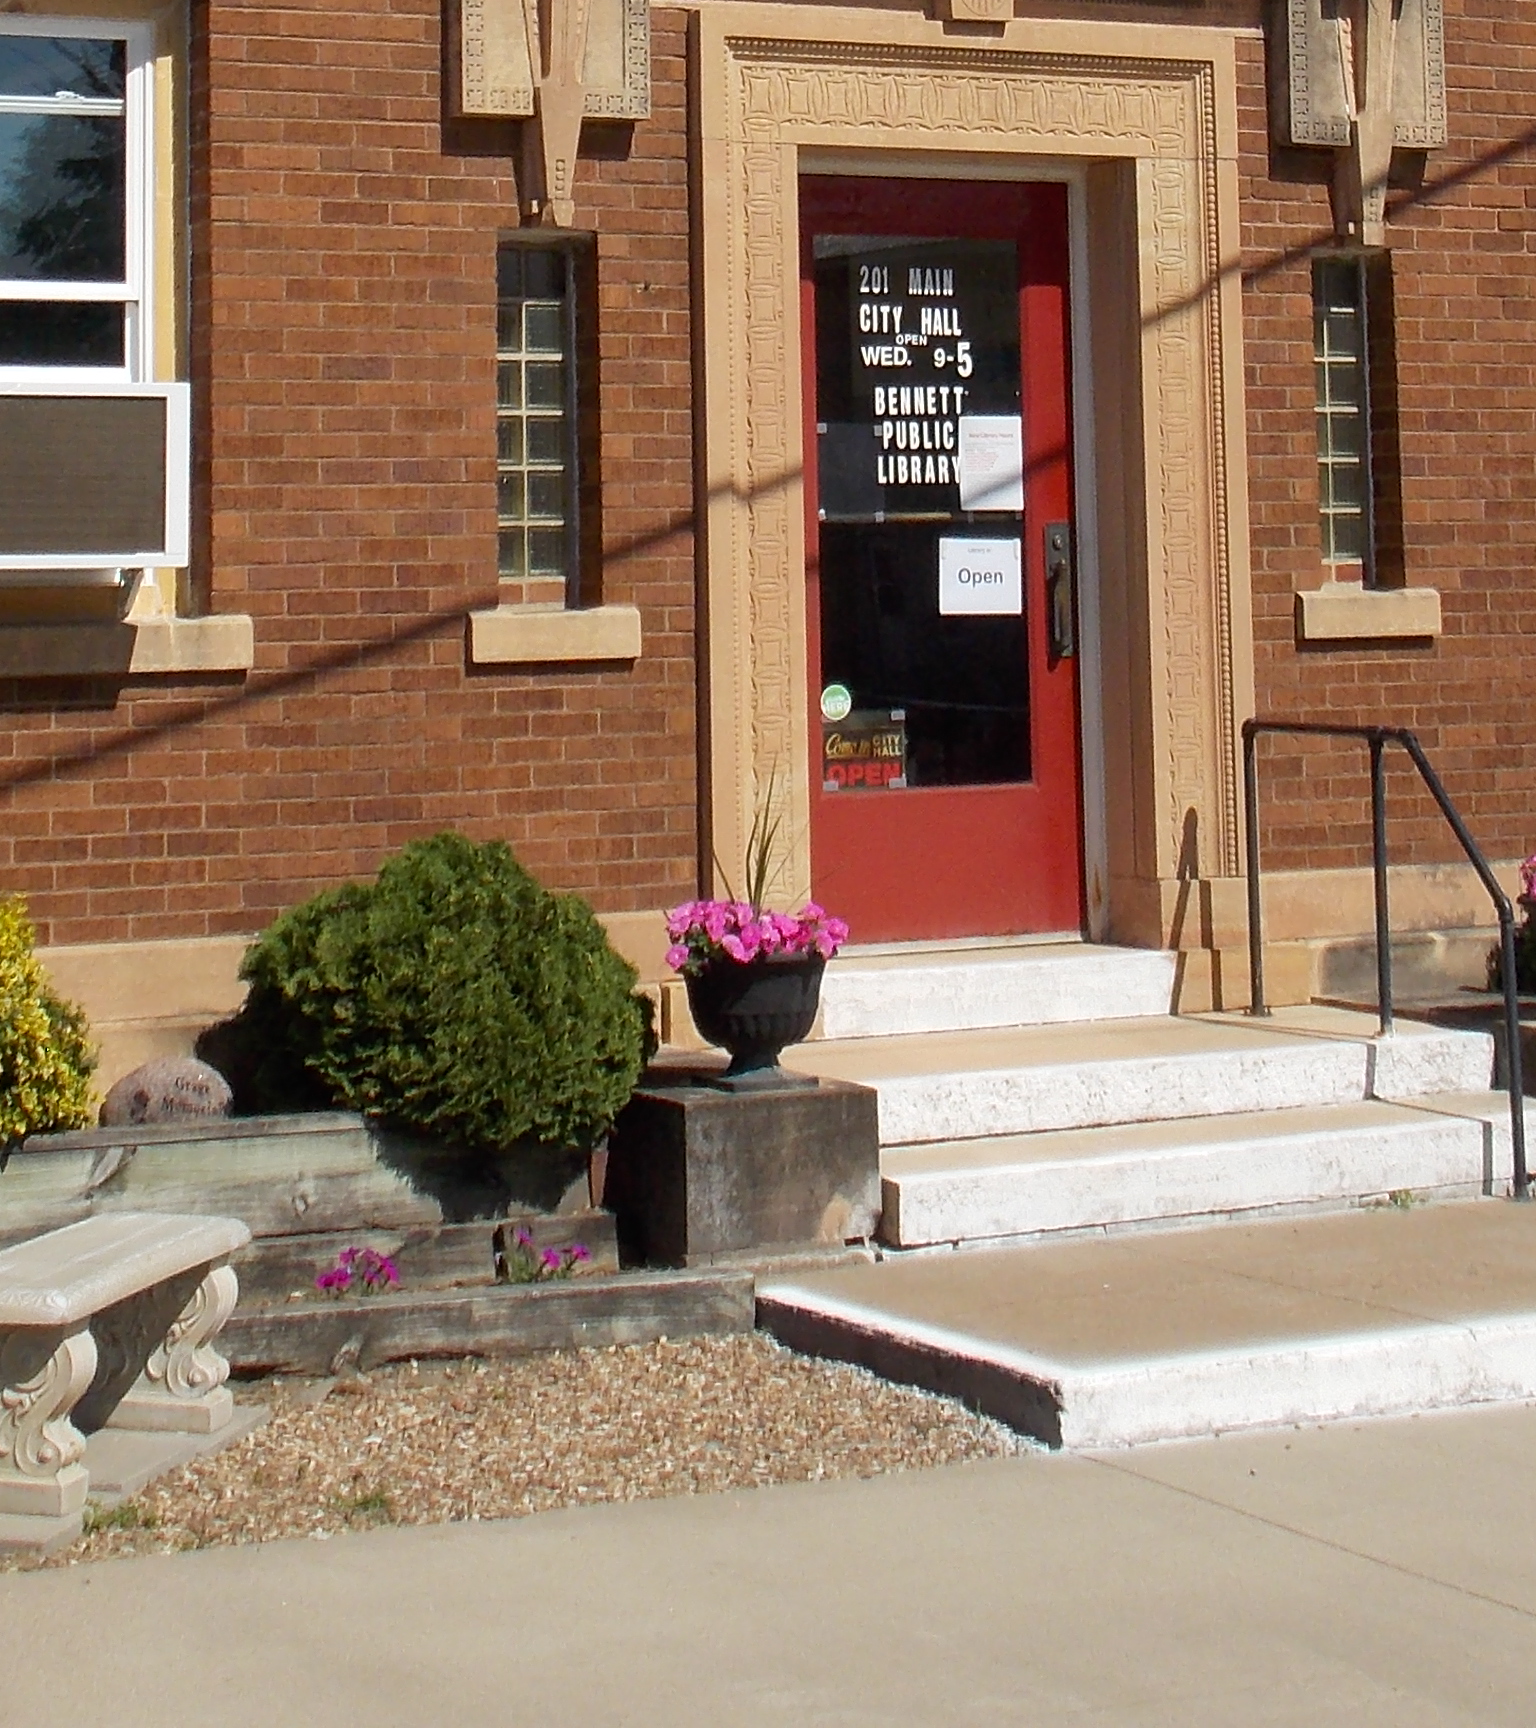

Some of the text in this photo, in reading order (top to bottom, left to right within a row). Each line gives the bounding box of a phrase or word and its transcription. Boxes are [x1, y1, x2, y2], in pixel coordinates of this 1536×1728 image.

[860, 265, 953, 296] 201 MAIN
[860, 303, 962, 336] CITY HALL
[895, 334, 927, 345] OPEN
[861, 342, 972, 377] WED. 9-5
[874, 386, 963, 415] BENNETT
[883, 421, 954, 449] PUBLIC
[877, 455, 960, 484] LIBRARY
[958, 567, 1003, 588] Open
[872, 734, 901, 745] CITY
[873, 745, 902, 757] HALL
[827, 762, 901, 787] OPEN
